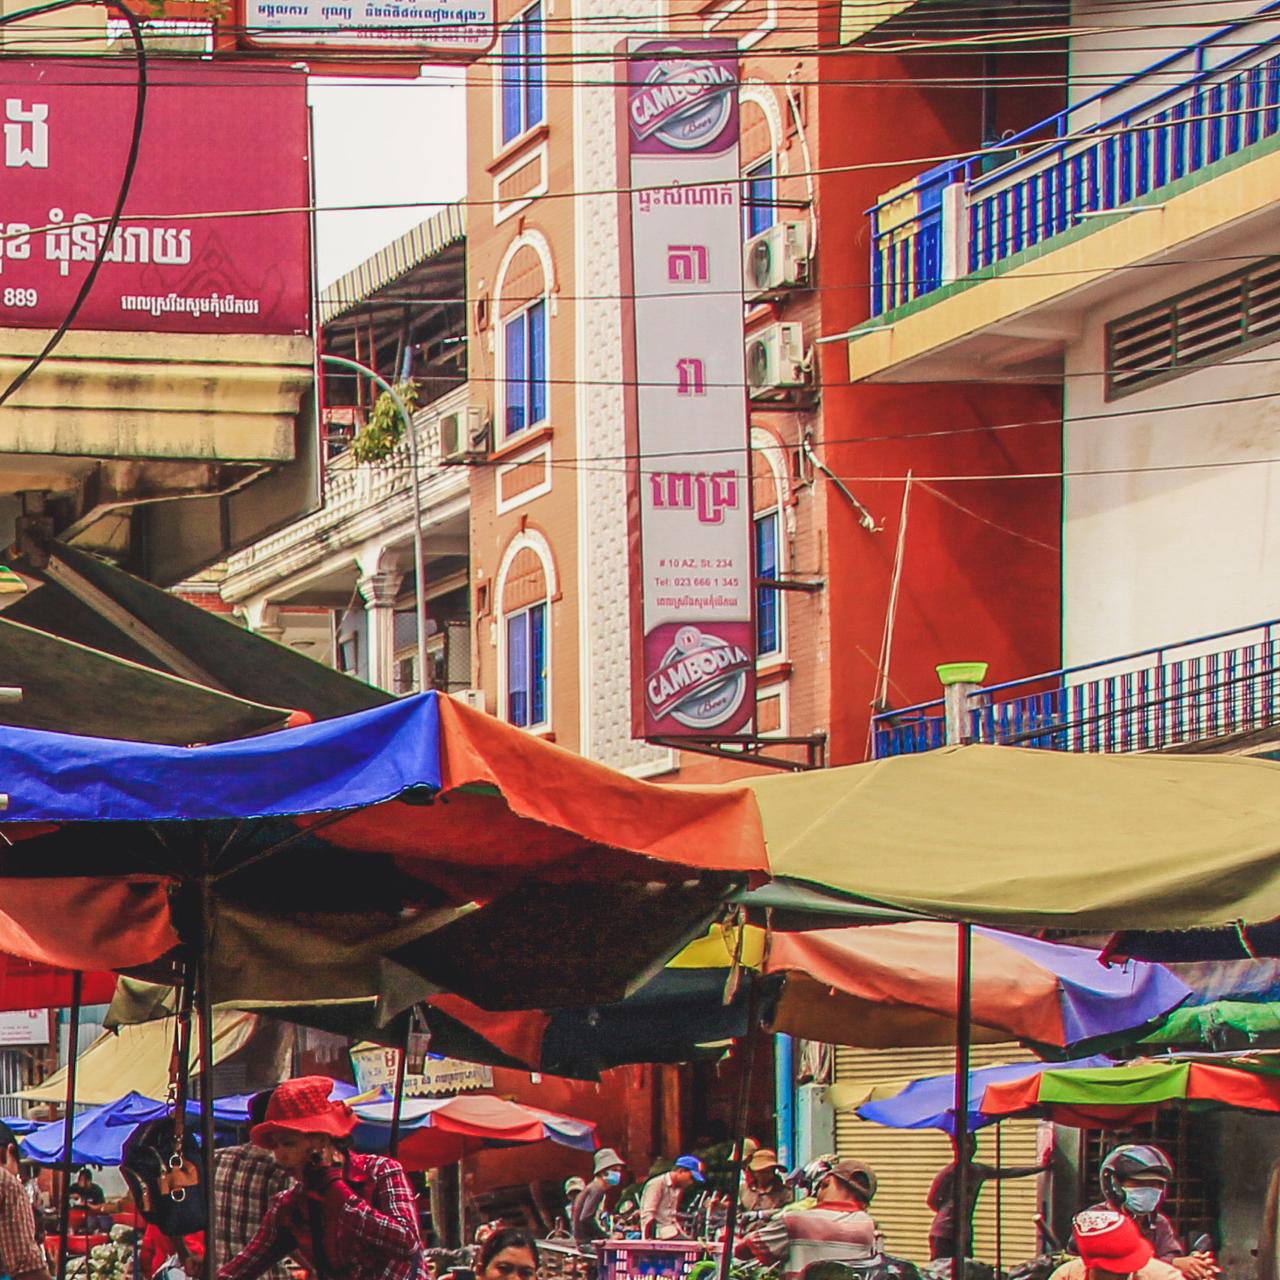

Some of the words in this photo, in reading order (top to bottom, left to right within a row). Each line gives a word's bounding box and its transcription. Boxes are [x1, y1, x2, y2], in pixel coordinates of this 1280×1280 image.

[631, 65, 735, 126] CAMBODIA
[4, 287, 38, 307] 889
[669, 559, 679, 569] 10
[716, 559, 733, 569] 234
[674, 577, 691, 587] 023
[723, 577, 739, 587] 345
[648, 646, 748, 705] CAMBODIA
